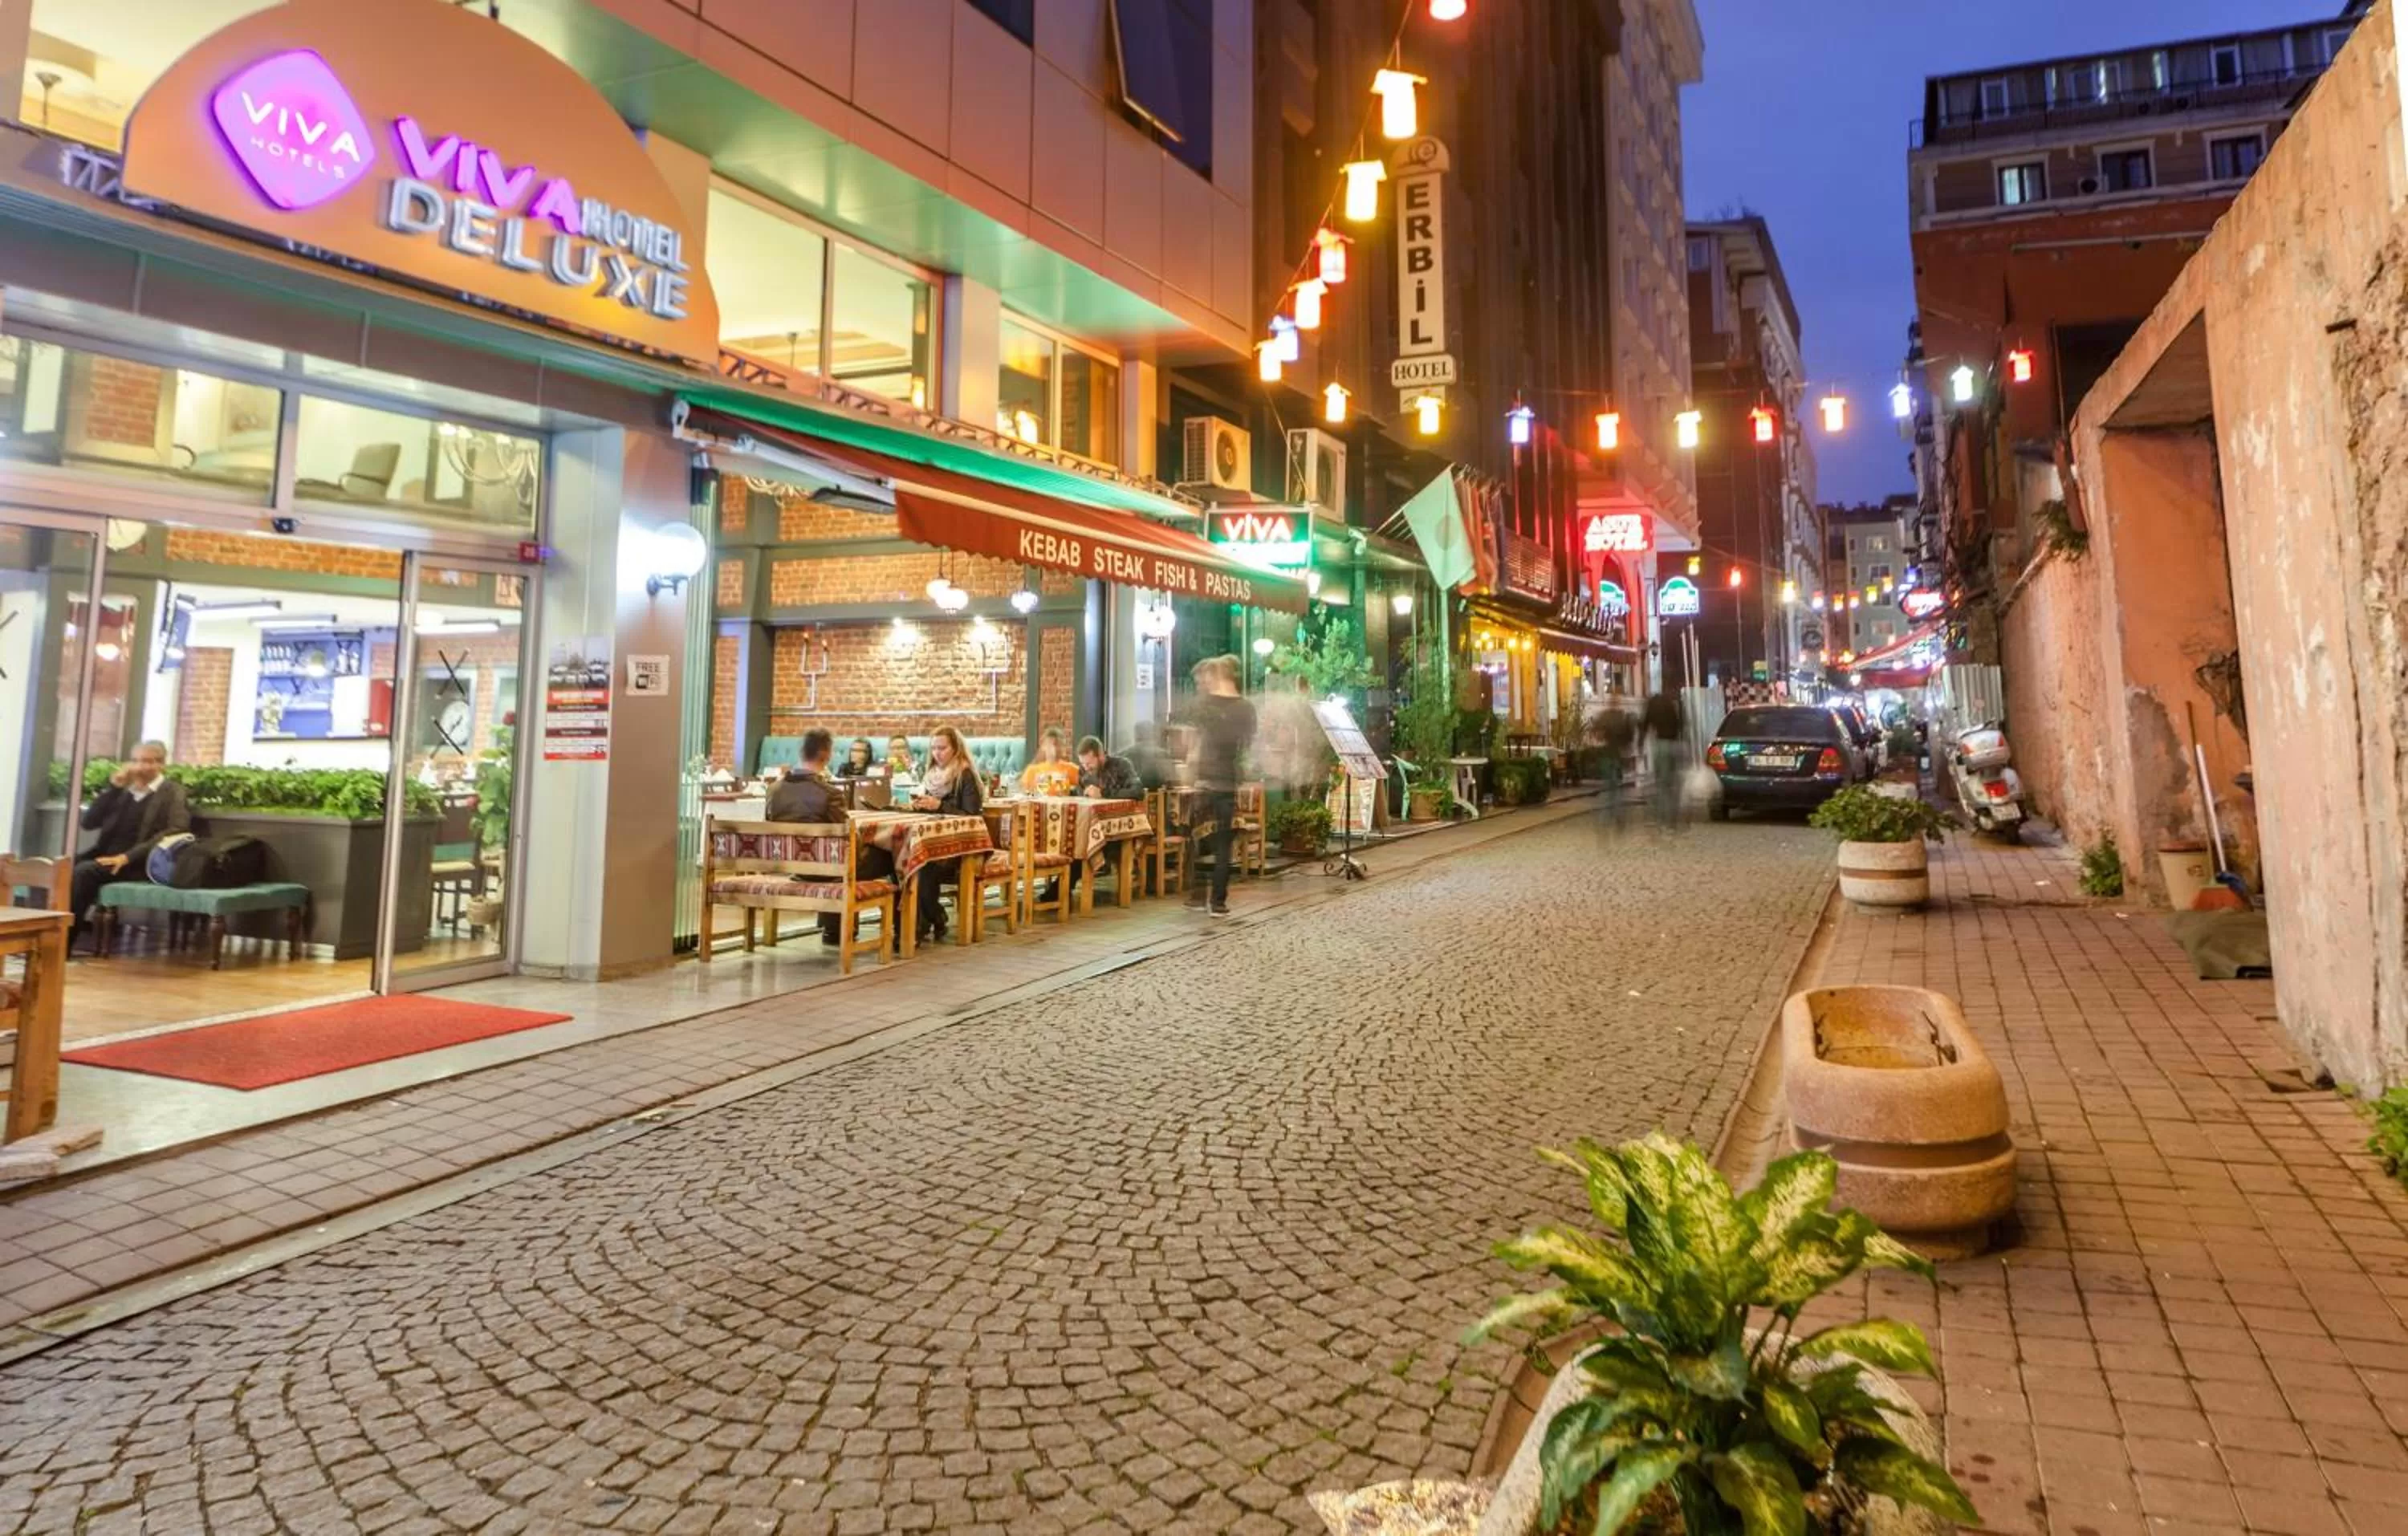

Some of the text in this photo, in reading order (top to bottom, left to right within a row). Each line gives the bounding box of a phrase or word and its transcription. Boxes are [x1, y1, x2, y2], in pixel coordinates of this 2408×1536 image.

[242, 91, 360, 162] VIVA
[250, 136, 345, 179] HOTELS
[393, 115, 689, 271] VIVA HOTEL
[388, 177, 689, 319] DELUXE
[1394, 361, 1451, 381] HOTEL
[1019, 529, 1081, 567] KEBAB
[1094, 547, 1144, 581] STEAK
[1155, 561, 1186, 589] FISH
[1206, 572, 1251, 600] PASTAS
[635, 662, 660, 673] FREE
